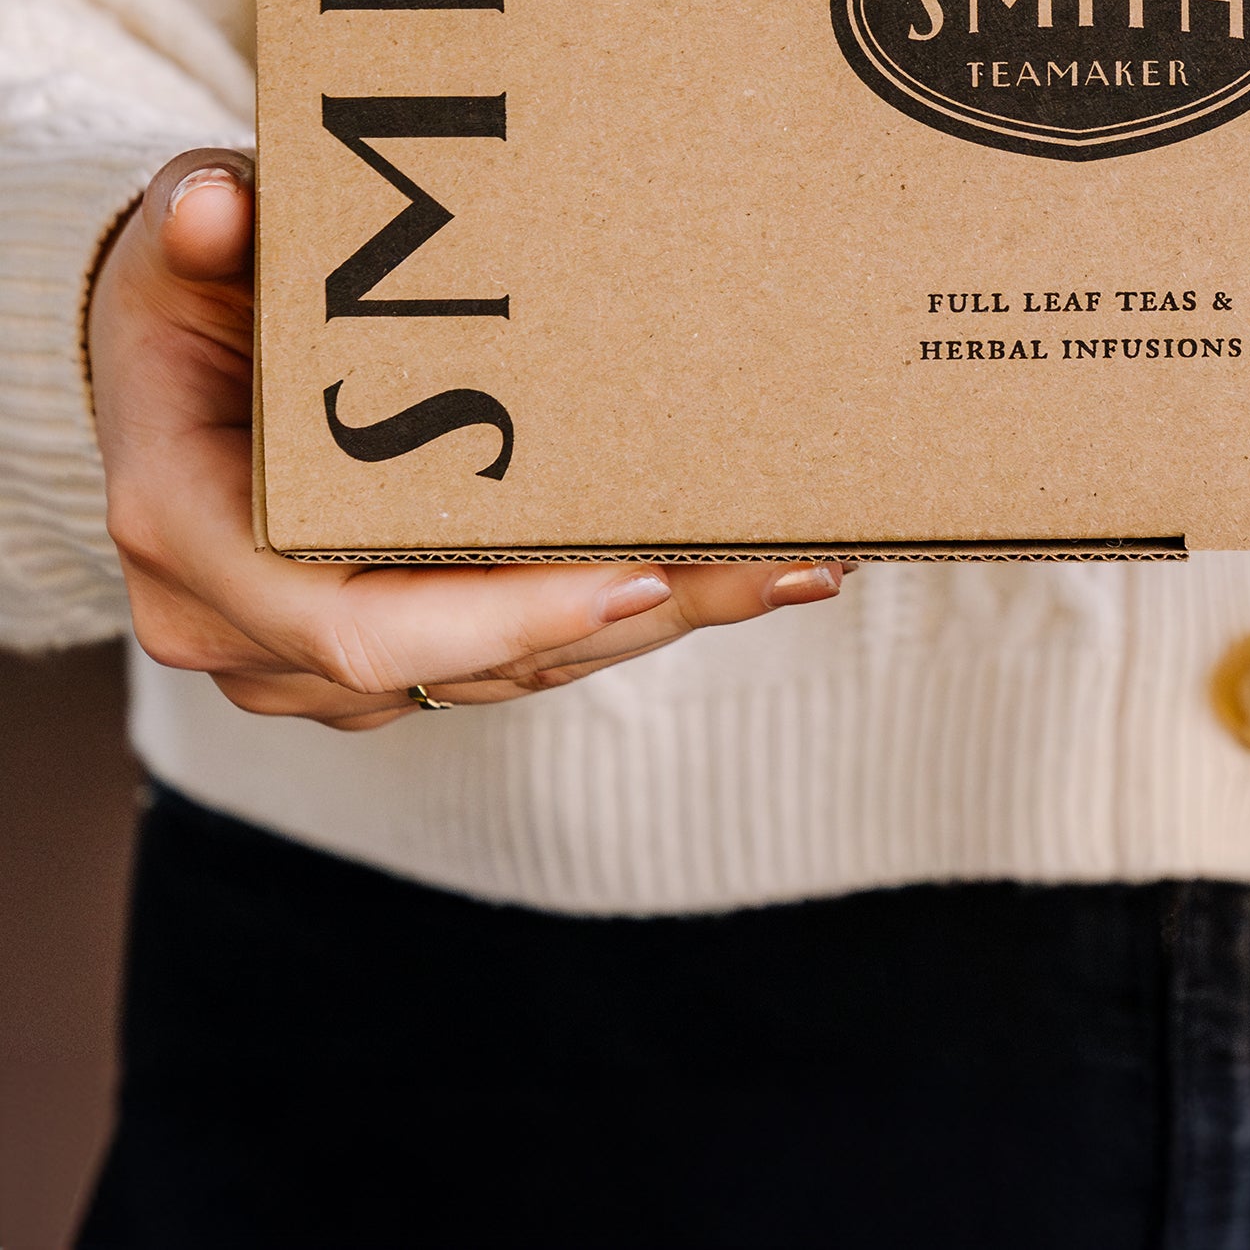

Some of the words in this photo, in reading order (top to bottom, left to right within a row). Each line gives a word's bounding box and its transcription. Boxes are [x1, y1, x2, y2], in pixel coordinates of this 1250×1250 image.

[966, 59, 1189, 88] TEAMAKER
[927, 292, 1010, 314] FULL
[1023, 291, 1102, 313] LEAF
[1114, 290, 1197, 312] TEAS
[1212, 291, 1233, 311] &
[919, 339, 1048, 361] HERBAL
[1061, 337, 1242, 360] INFUSIONS
